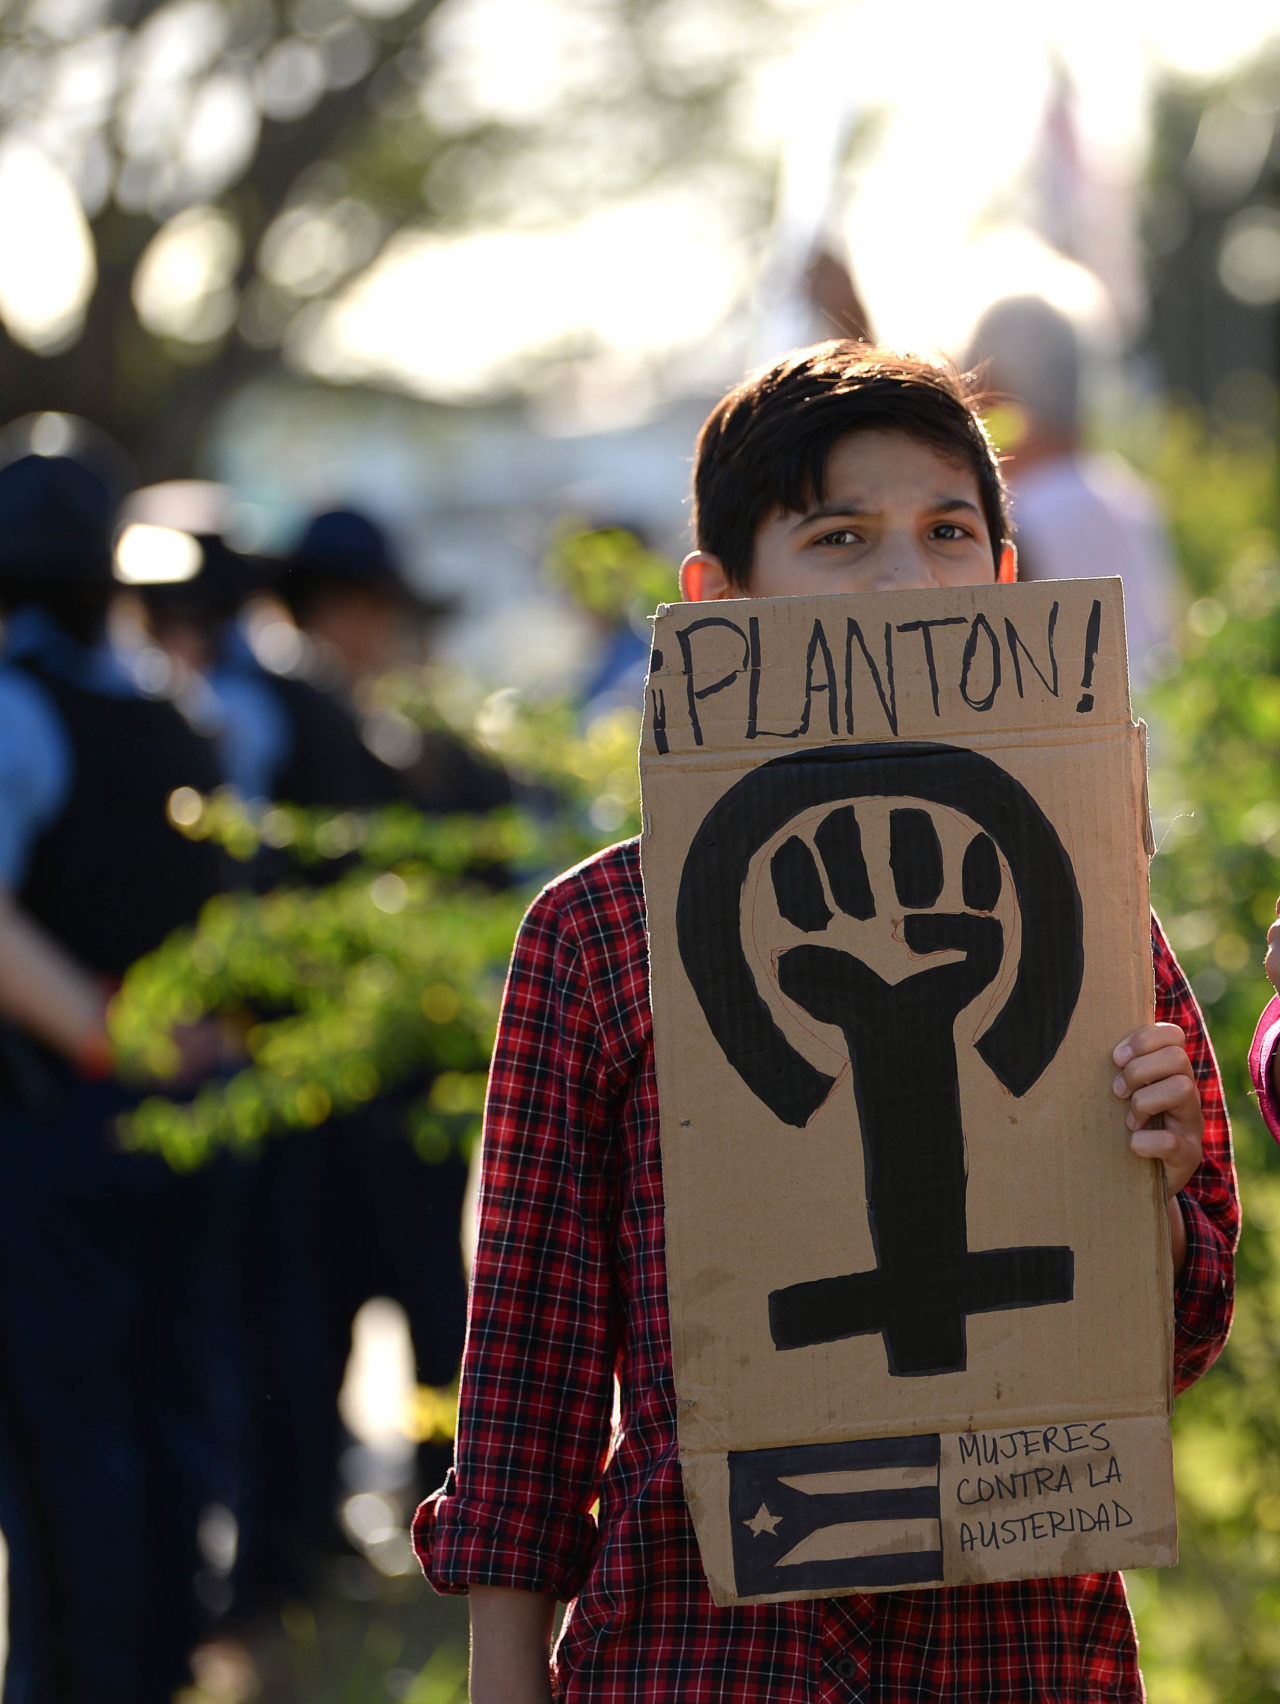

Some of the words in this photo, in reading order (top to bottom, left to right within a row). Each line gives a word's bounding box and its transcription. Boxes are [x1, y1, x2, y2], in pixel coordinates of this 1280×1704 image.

[957, 1422, 1111, 1466] MUJERES
[956, 1466, 1073, 1506] CONTRA
[1088, 1456, 1123, 1487] LA
[959, 1500, 1133, 1553] AUSTERIDAD
